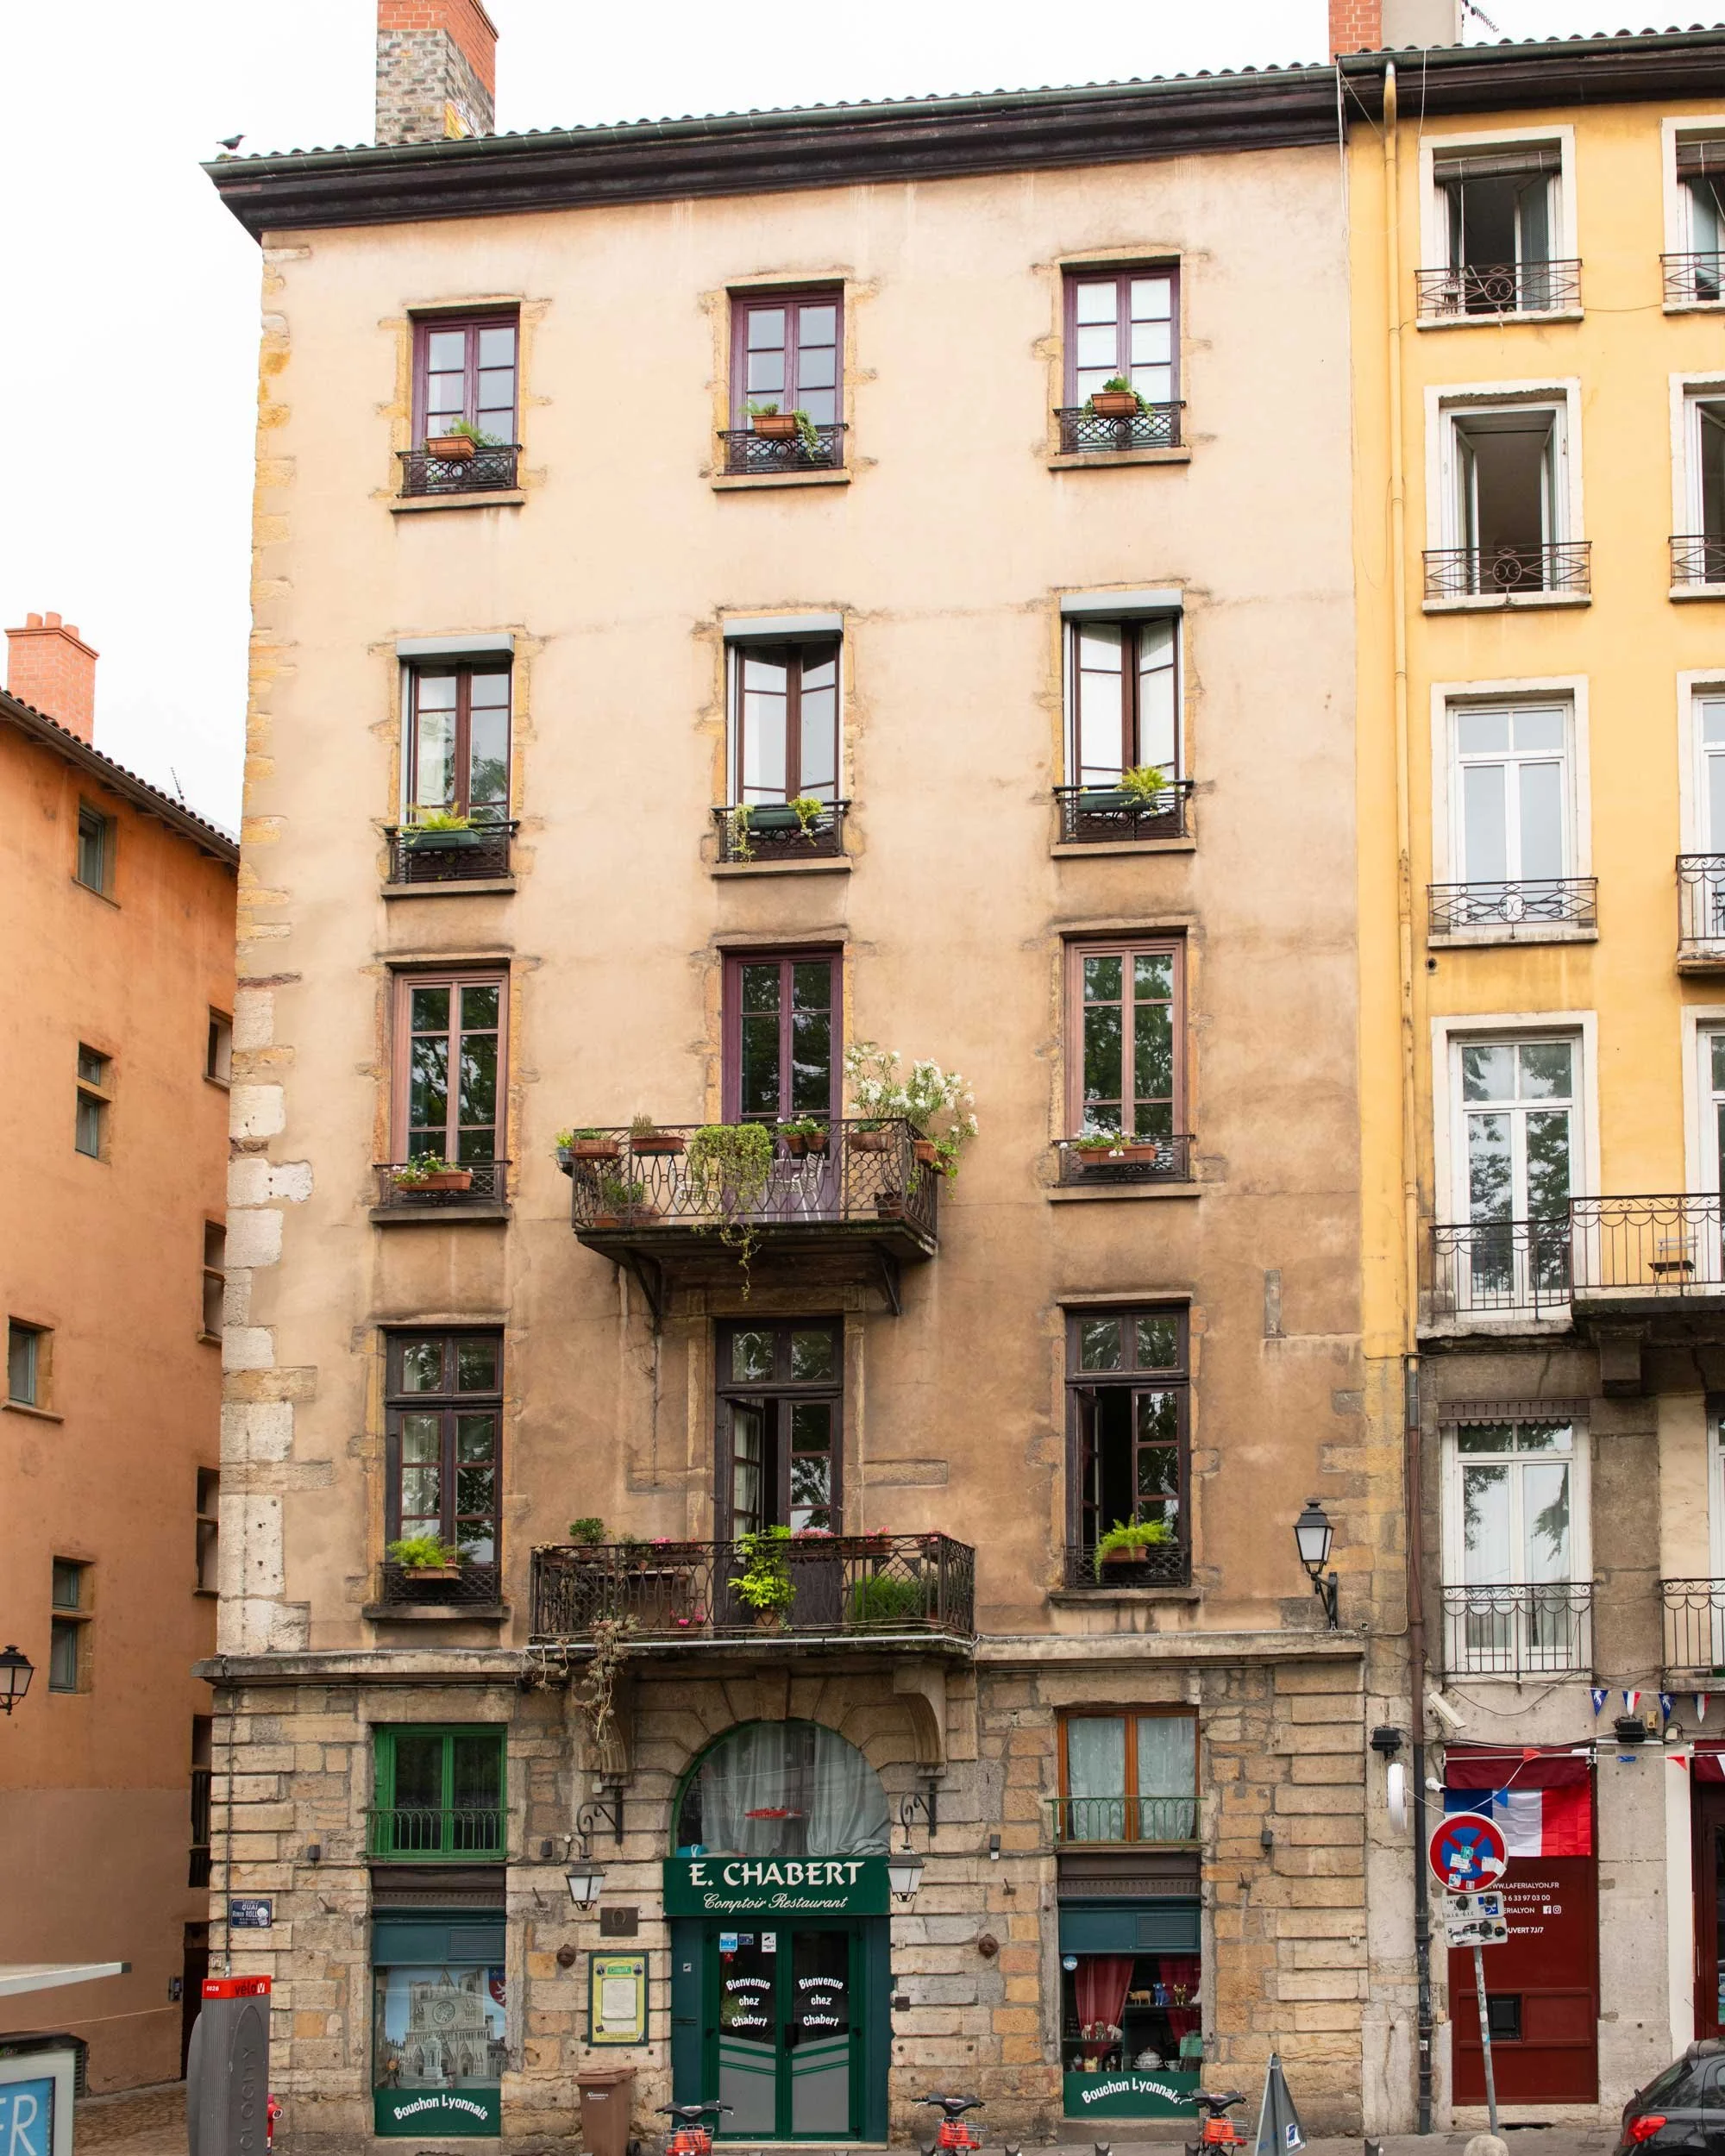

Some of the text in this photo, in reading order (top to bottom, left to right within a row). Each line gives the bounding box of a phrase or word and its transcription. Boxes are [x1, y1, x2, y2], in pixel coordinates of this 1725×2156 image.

[688, 1861, 866, 1887] E. CHABERT
[704, 1892, 849, 1914] Comptoir Restaurant
[725, 1977, 771, 1991] Bienvenue
[798, 1977, 844, 1990] Bienvenue
[738, 1995, 760, 2006] chez
[811, 1994, 832, 2005] chez
[731, 2014, 768, 2028] Chabert
[803, 2014, 839, 2027] Chabert
[1081, 2080, 1130, 2104] Bouchon
[240, 2047, 256, 2156] CLOCITY
[393, 2094, 488, 2121] Bouchon Lyonnais
